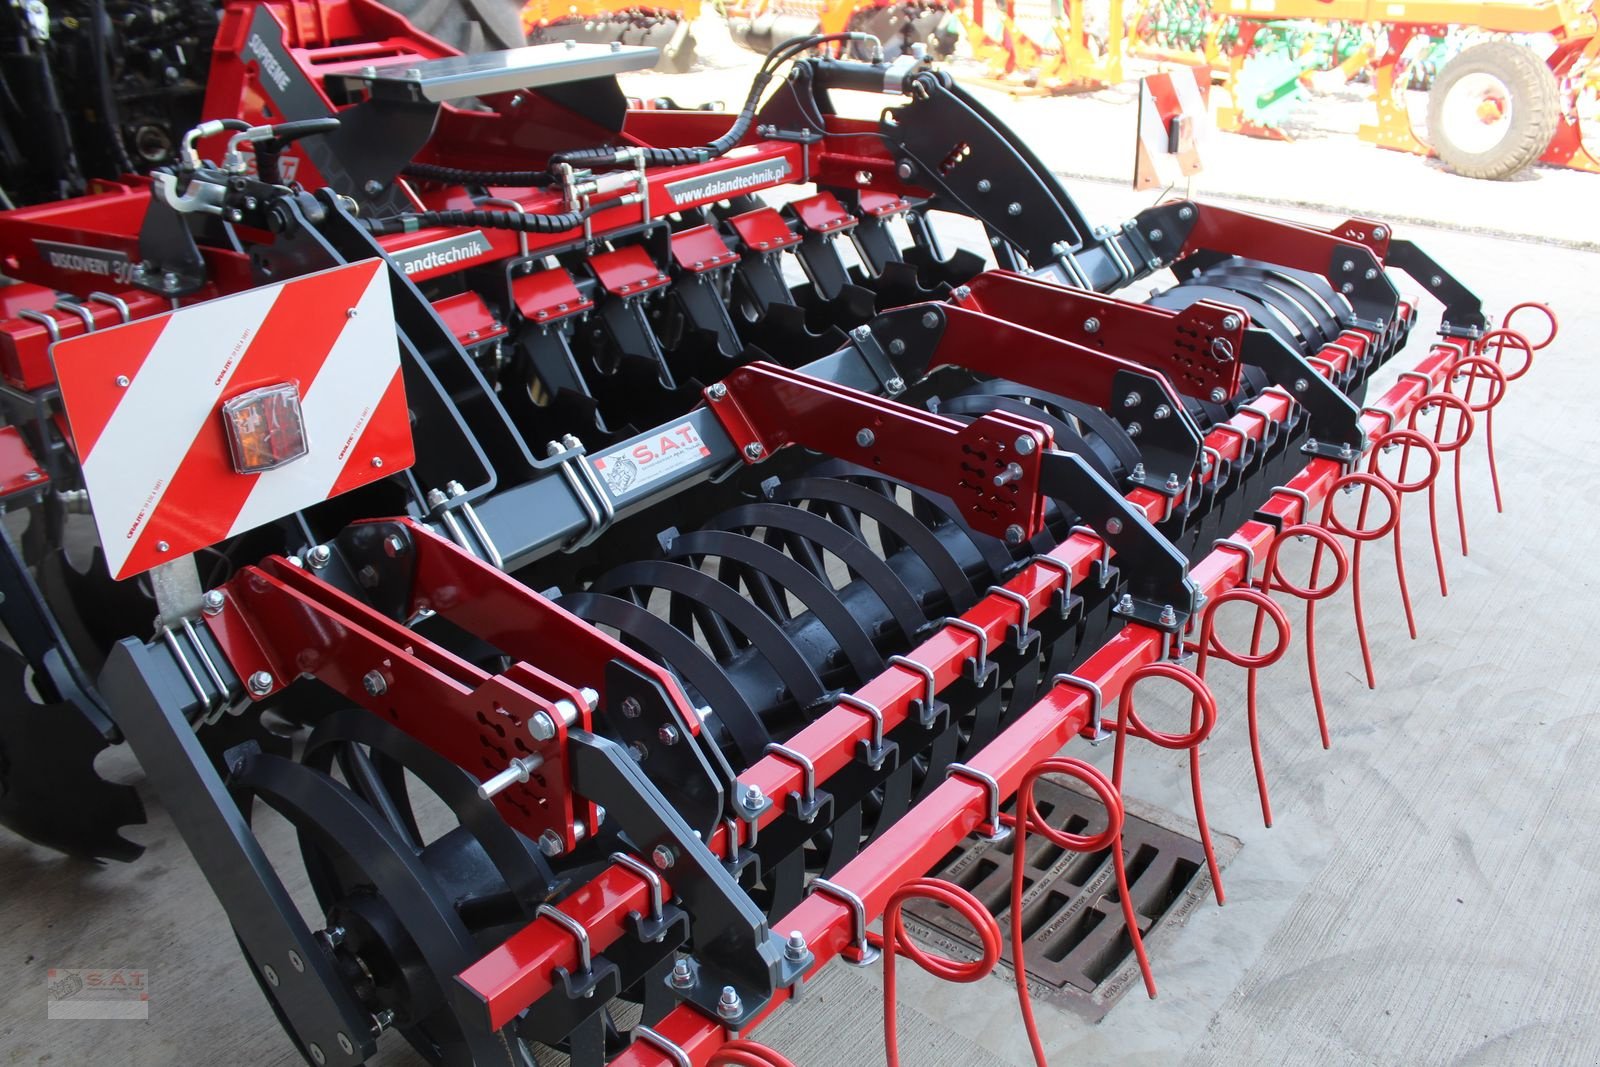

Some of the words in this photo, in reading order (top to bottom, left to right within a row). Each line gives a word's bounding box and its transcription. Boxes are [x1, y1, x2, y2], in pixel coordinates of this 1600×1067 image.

[248, 33, 291, 92] SUPREME
[674, 165, 785, 205] www.dalandtechnik.pl
[49, 251, 110, 276] DISCOVERY
[632, 426, 699, 465] S.A.T.
